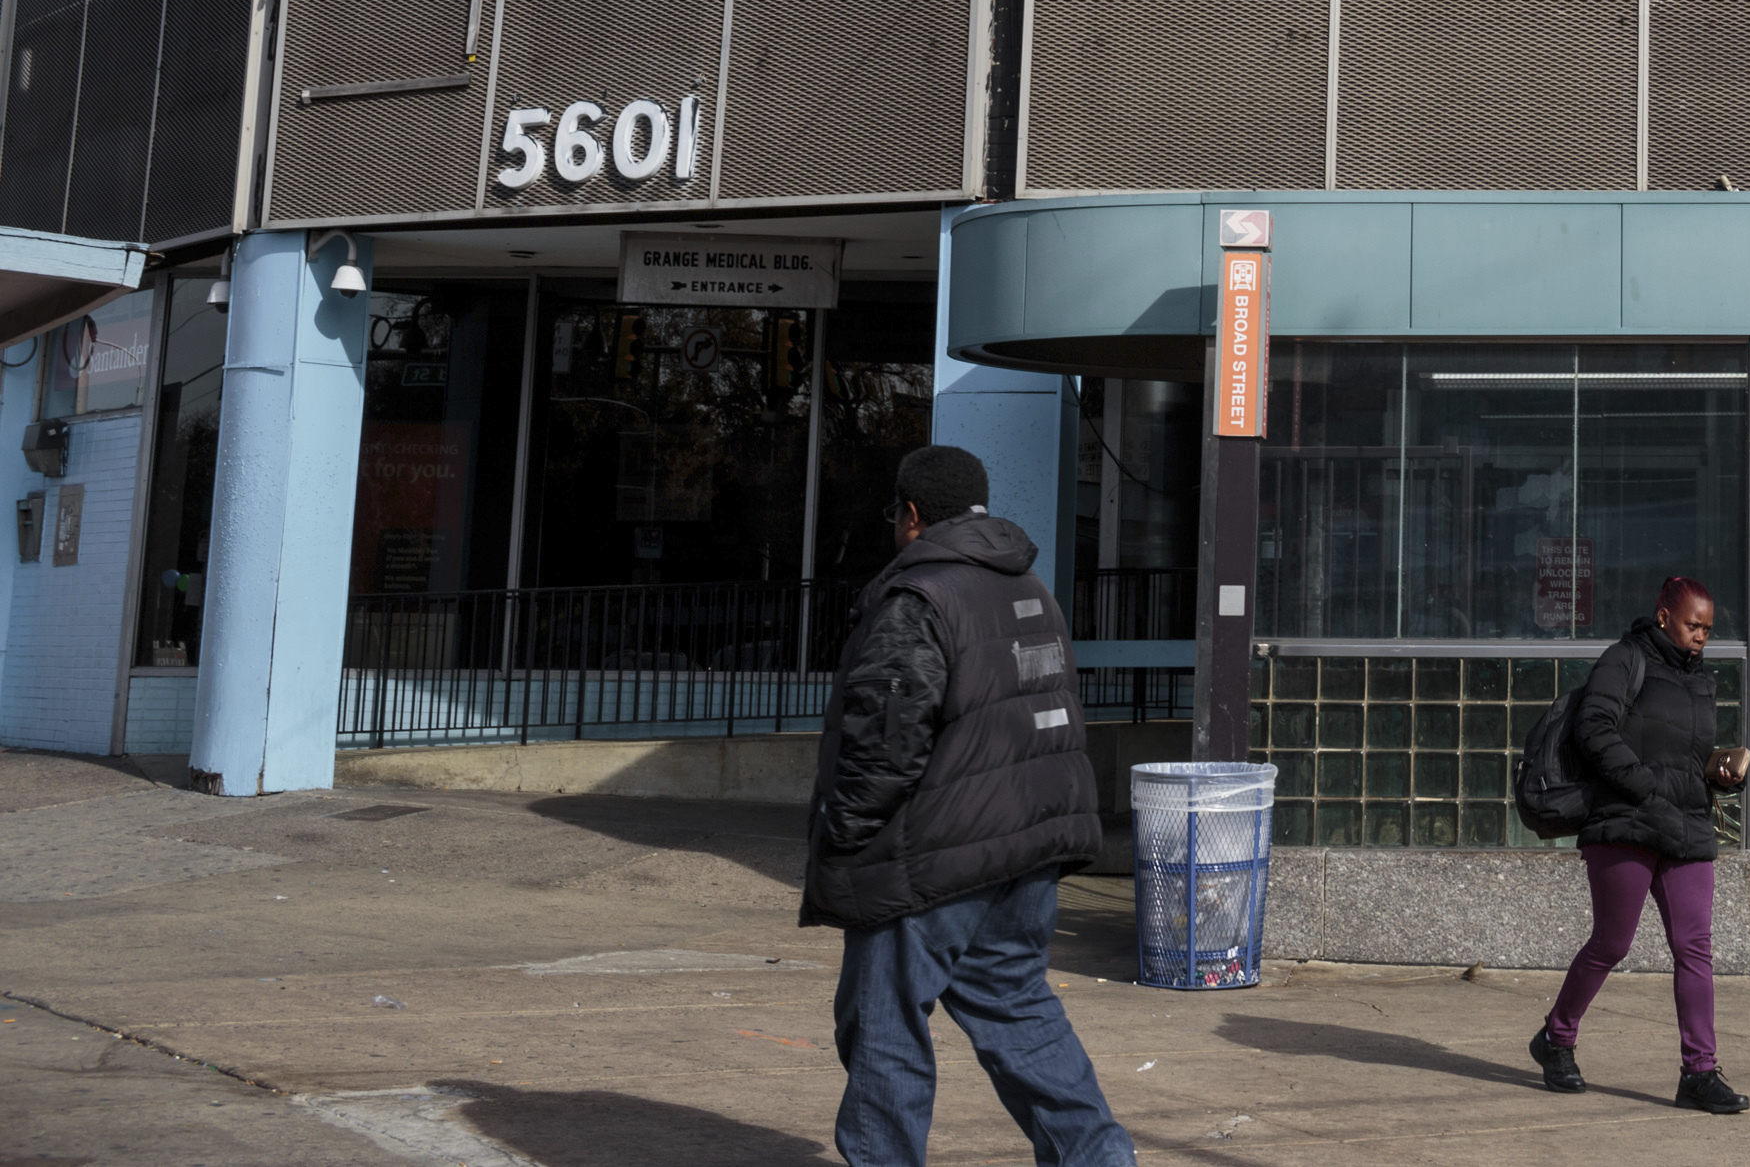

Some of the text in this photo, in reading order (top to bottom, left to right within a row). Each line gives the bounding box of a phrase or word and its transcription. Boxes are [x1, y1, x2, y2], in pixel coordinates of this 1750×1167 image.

[498, 97, 700, 188] 5601
[643, 251, 813, 271] GRANGE MEDICAL BLDG.
[691, 281, 763, 294] ENTRANCE
[1230, 295, 1249, 428] BROAD STREET
[394, 443, 459, 455] CHECKING
[375, 457, 406, 478] for
[409, 463, 456, 483] you.
[1541, 545, 1562, 555] THIS
[1540, 556, 1553, 565] TO
